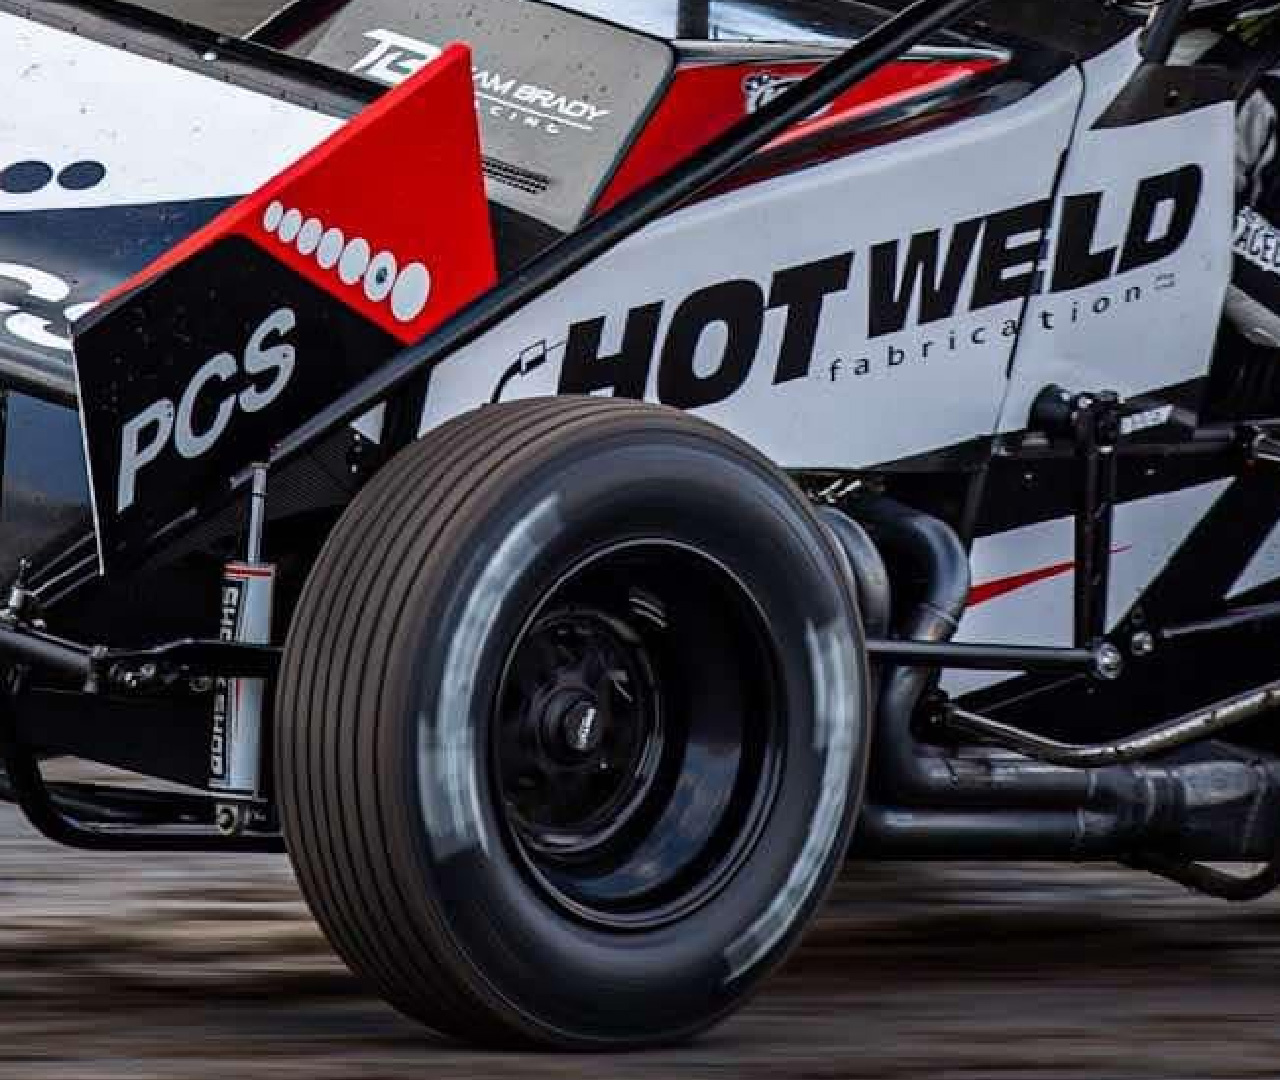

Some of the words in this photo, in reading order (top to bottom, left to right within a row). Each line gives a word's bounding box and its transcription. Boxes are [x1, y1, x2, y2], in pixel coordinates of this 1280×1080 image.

[514, 84, 612, 120] BRADY
[556, 252, 854, 409] HOT
[867, 163, 1204, 340] WELD
[828, 284, 1143, 383] fabrication
[117, 306, 297, 513] PCS
